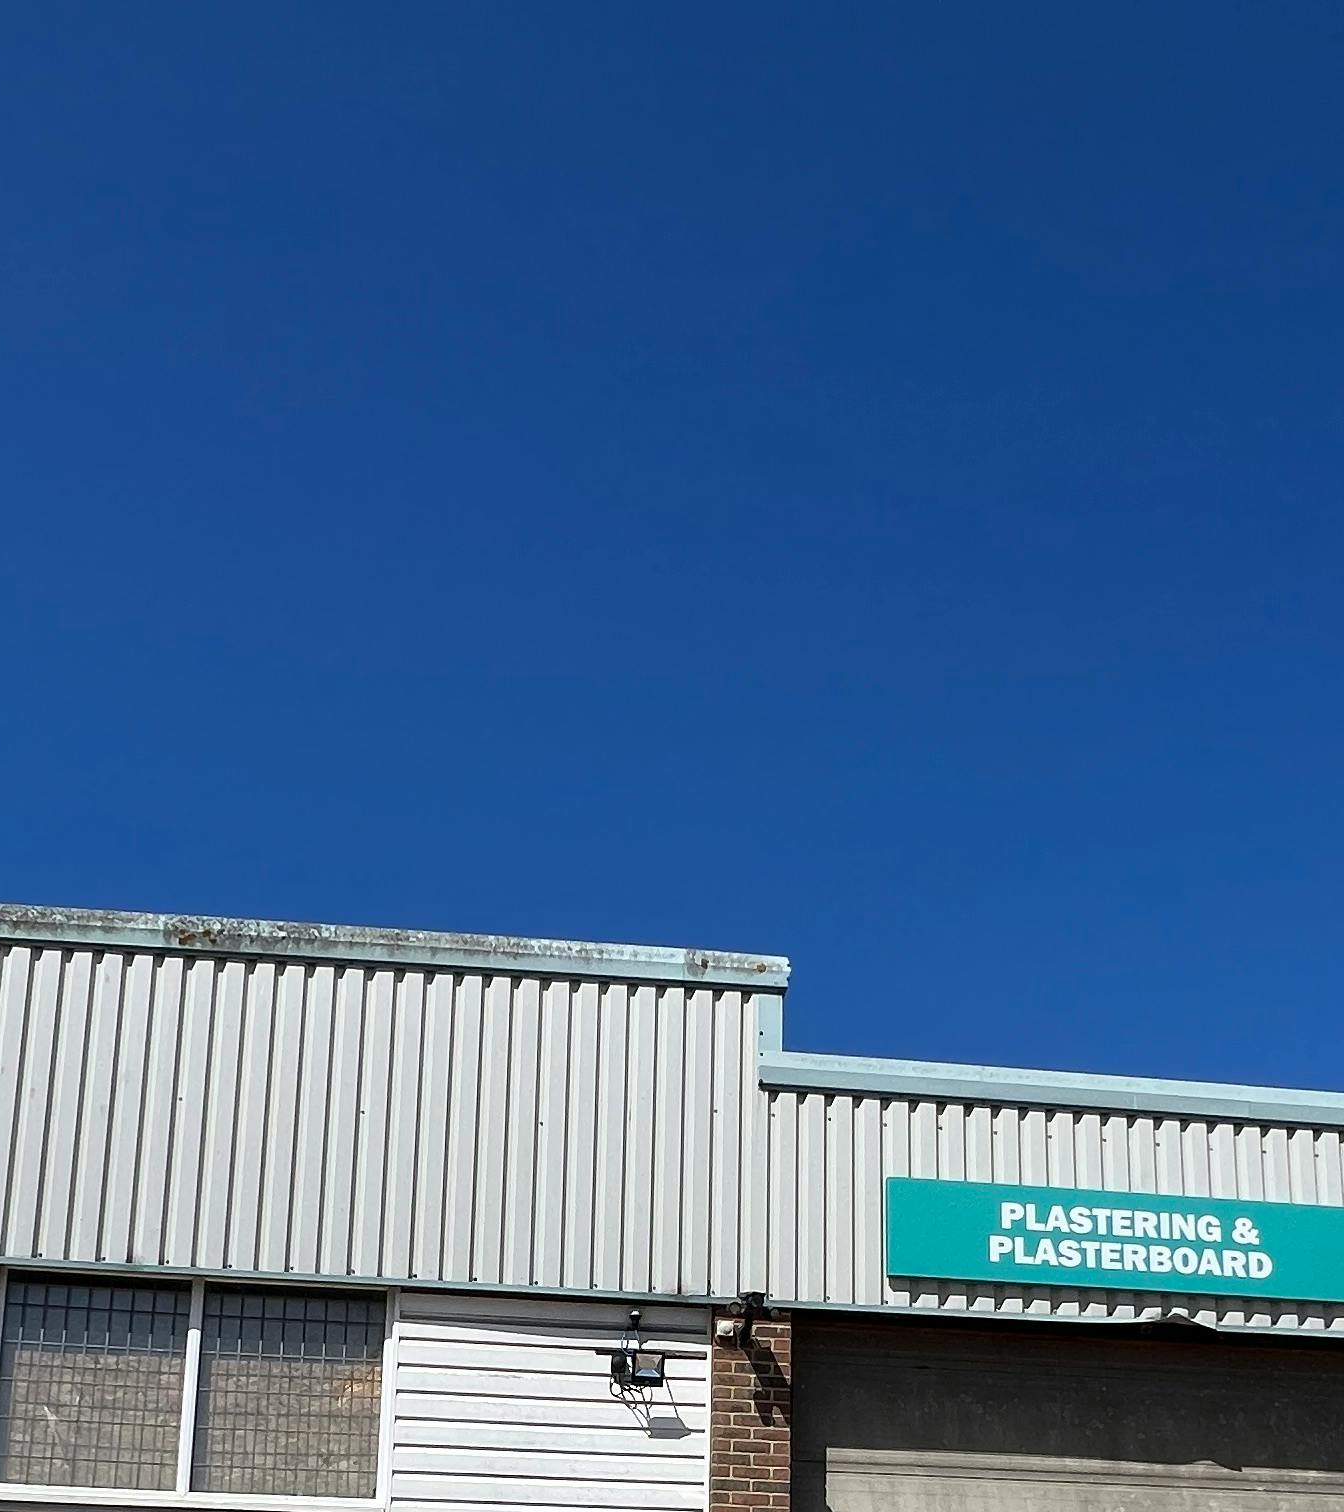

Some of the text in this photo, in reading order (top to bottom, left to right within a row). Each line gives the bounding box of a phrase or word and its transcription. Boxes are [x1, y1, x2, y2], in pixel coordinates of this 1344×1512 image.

[1001, 1202, 1260, 1244] PLASTERING &
[989, 1235, 1272, 1279] PLASTERBOARD
